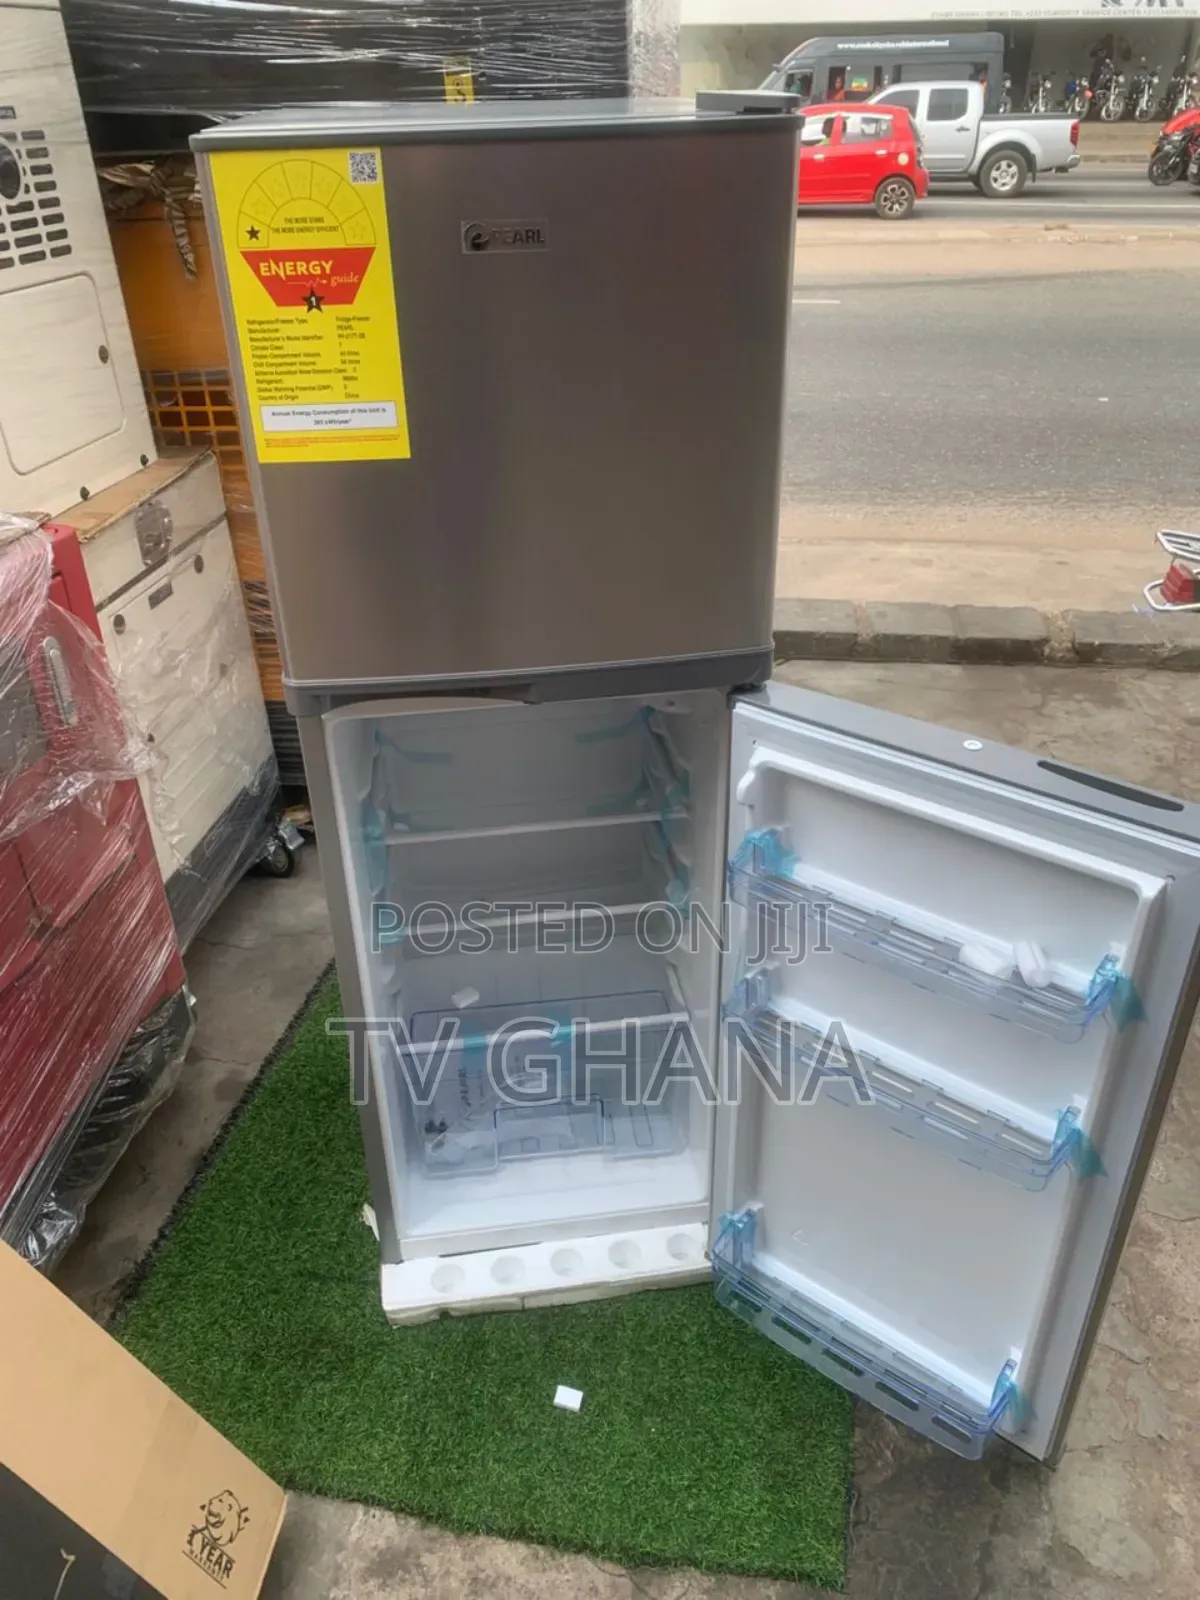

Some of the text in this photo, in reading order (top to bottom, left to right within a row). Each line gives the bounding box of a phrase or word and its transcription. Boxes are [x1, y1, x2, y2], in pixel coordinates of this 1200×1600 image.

[259, 258, 334, 280] ENERGY
[330, 271, 360, 287] guide
[310, 296, 317, 307] 1
[199, 1537, 234, 1579] YEAR
